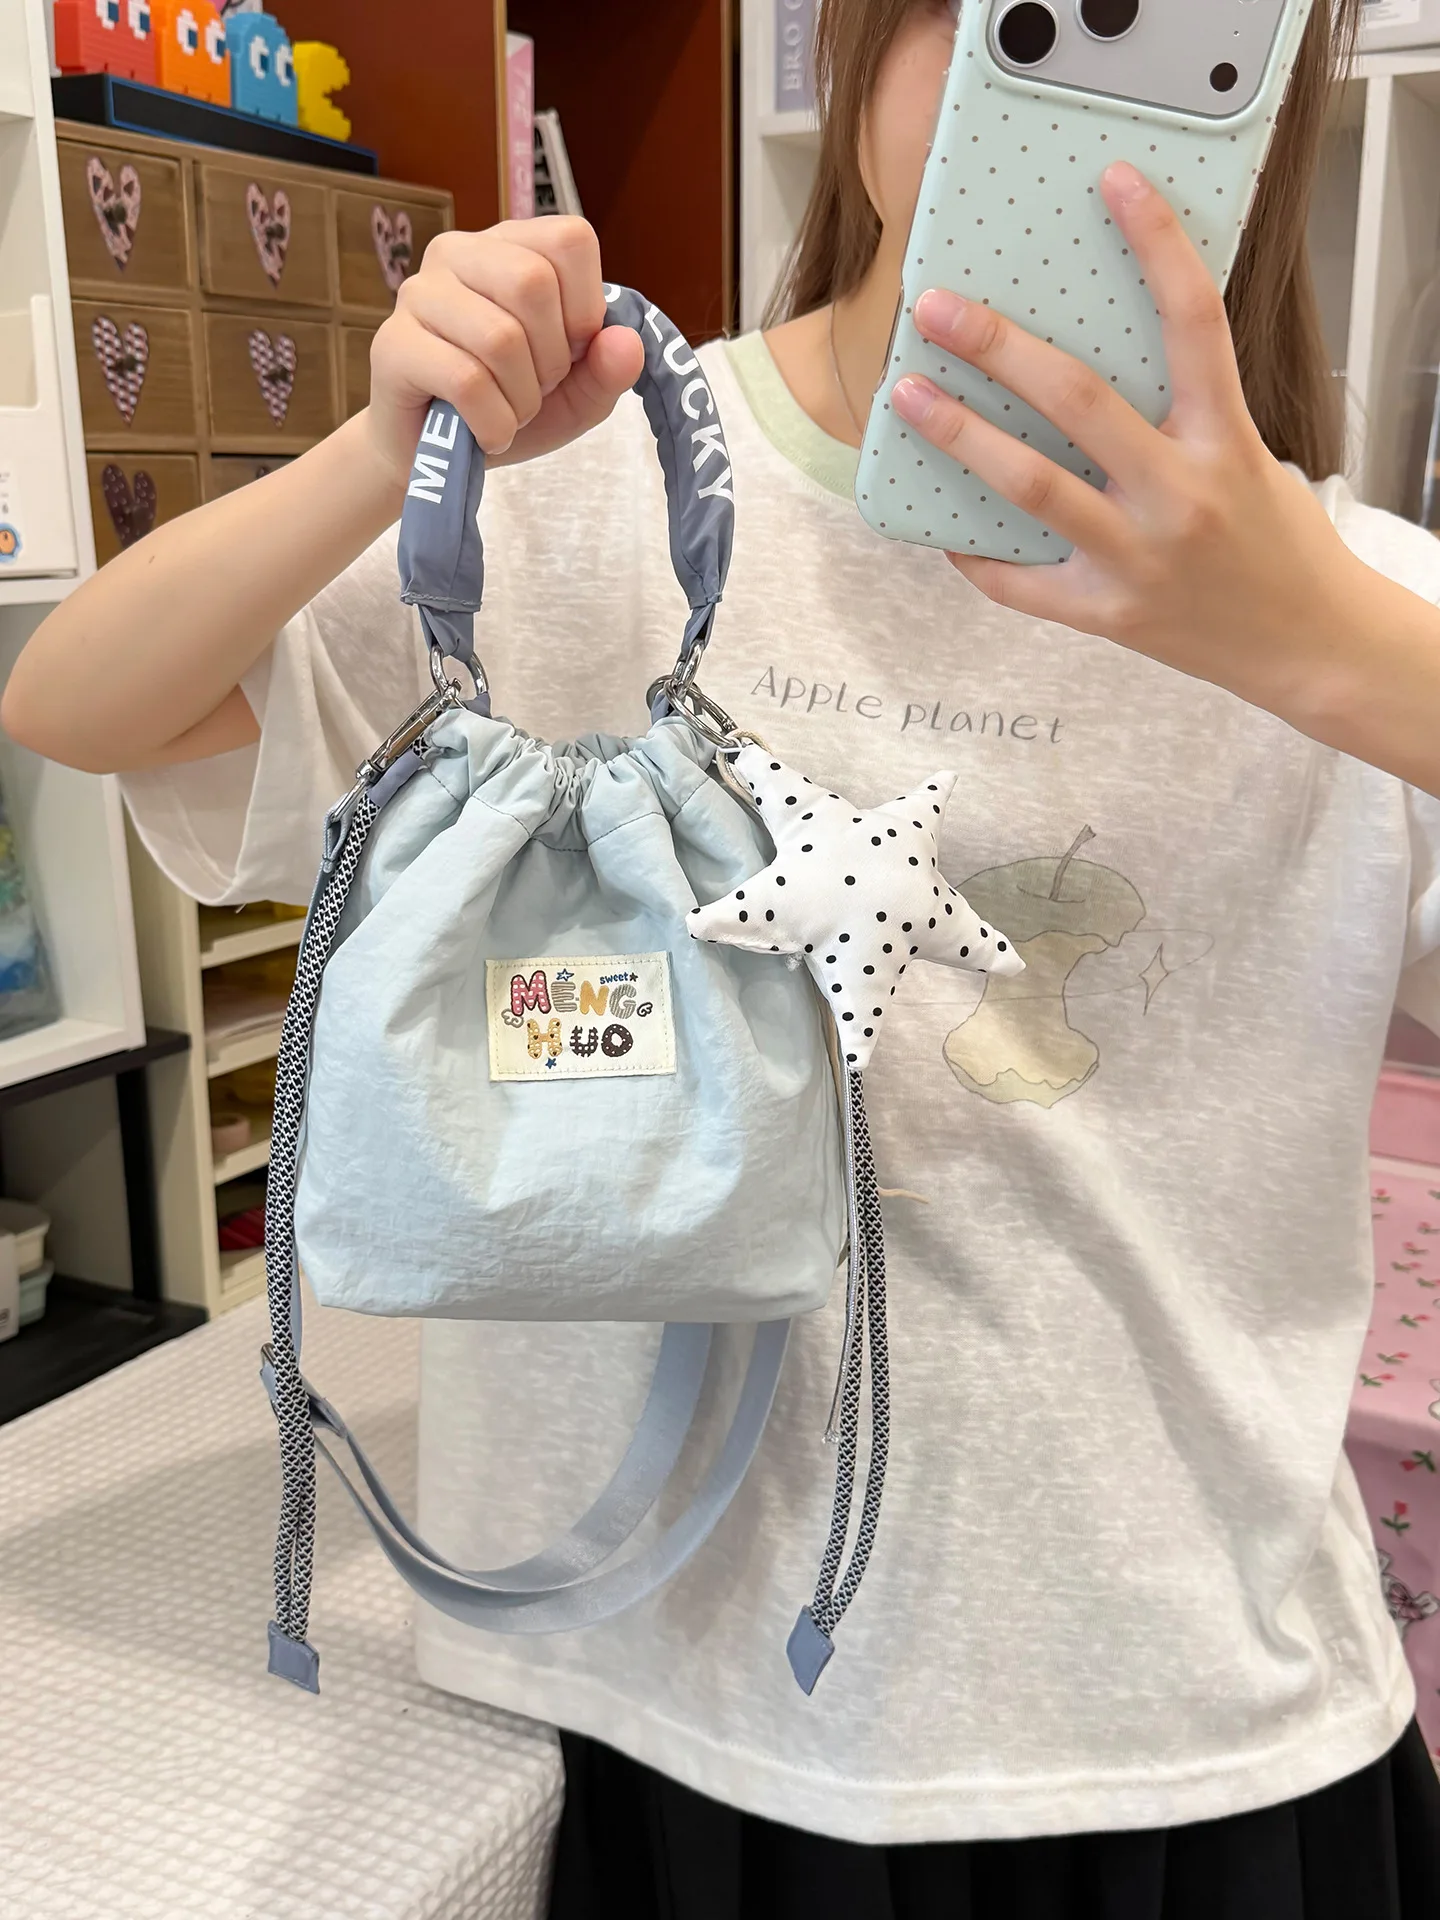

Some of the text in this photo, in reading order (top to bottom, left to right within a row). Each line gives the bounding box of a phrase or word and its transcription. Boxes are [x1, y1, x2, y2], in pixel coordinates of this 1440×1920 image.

[643, 304, 735, 506] LUCKY
[750, 665, 1065, 744] Apple planet
[510, 970, 638, 1020] MENG
[599, 971, 629, 985] sweet
[526, 1017, 634, 1060] HUO
